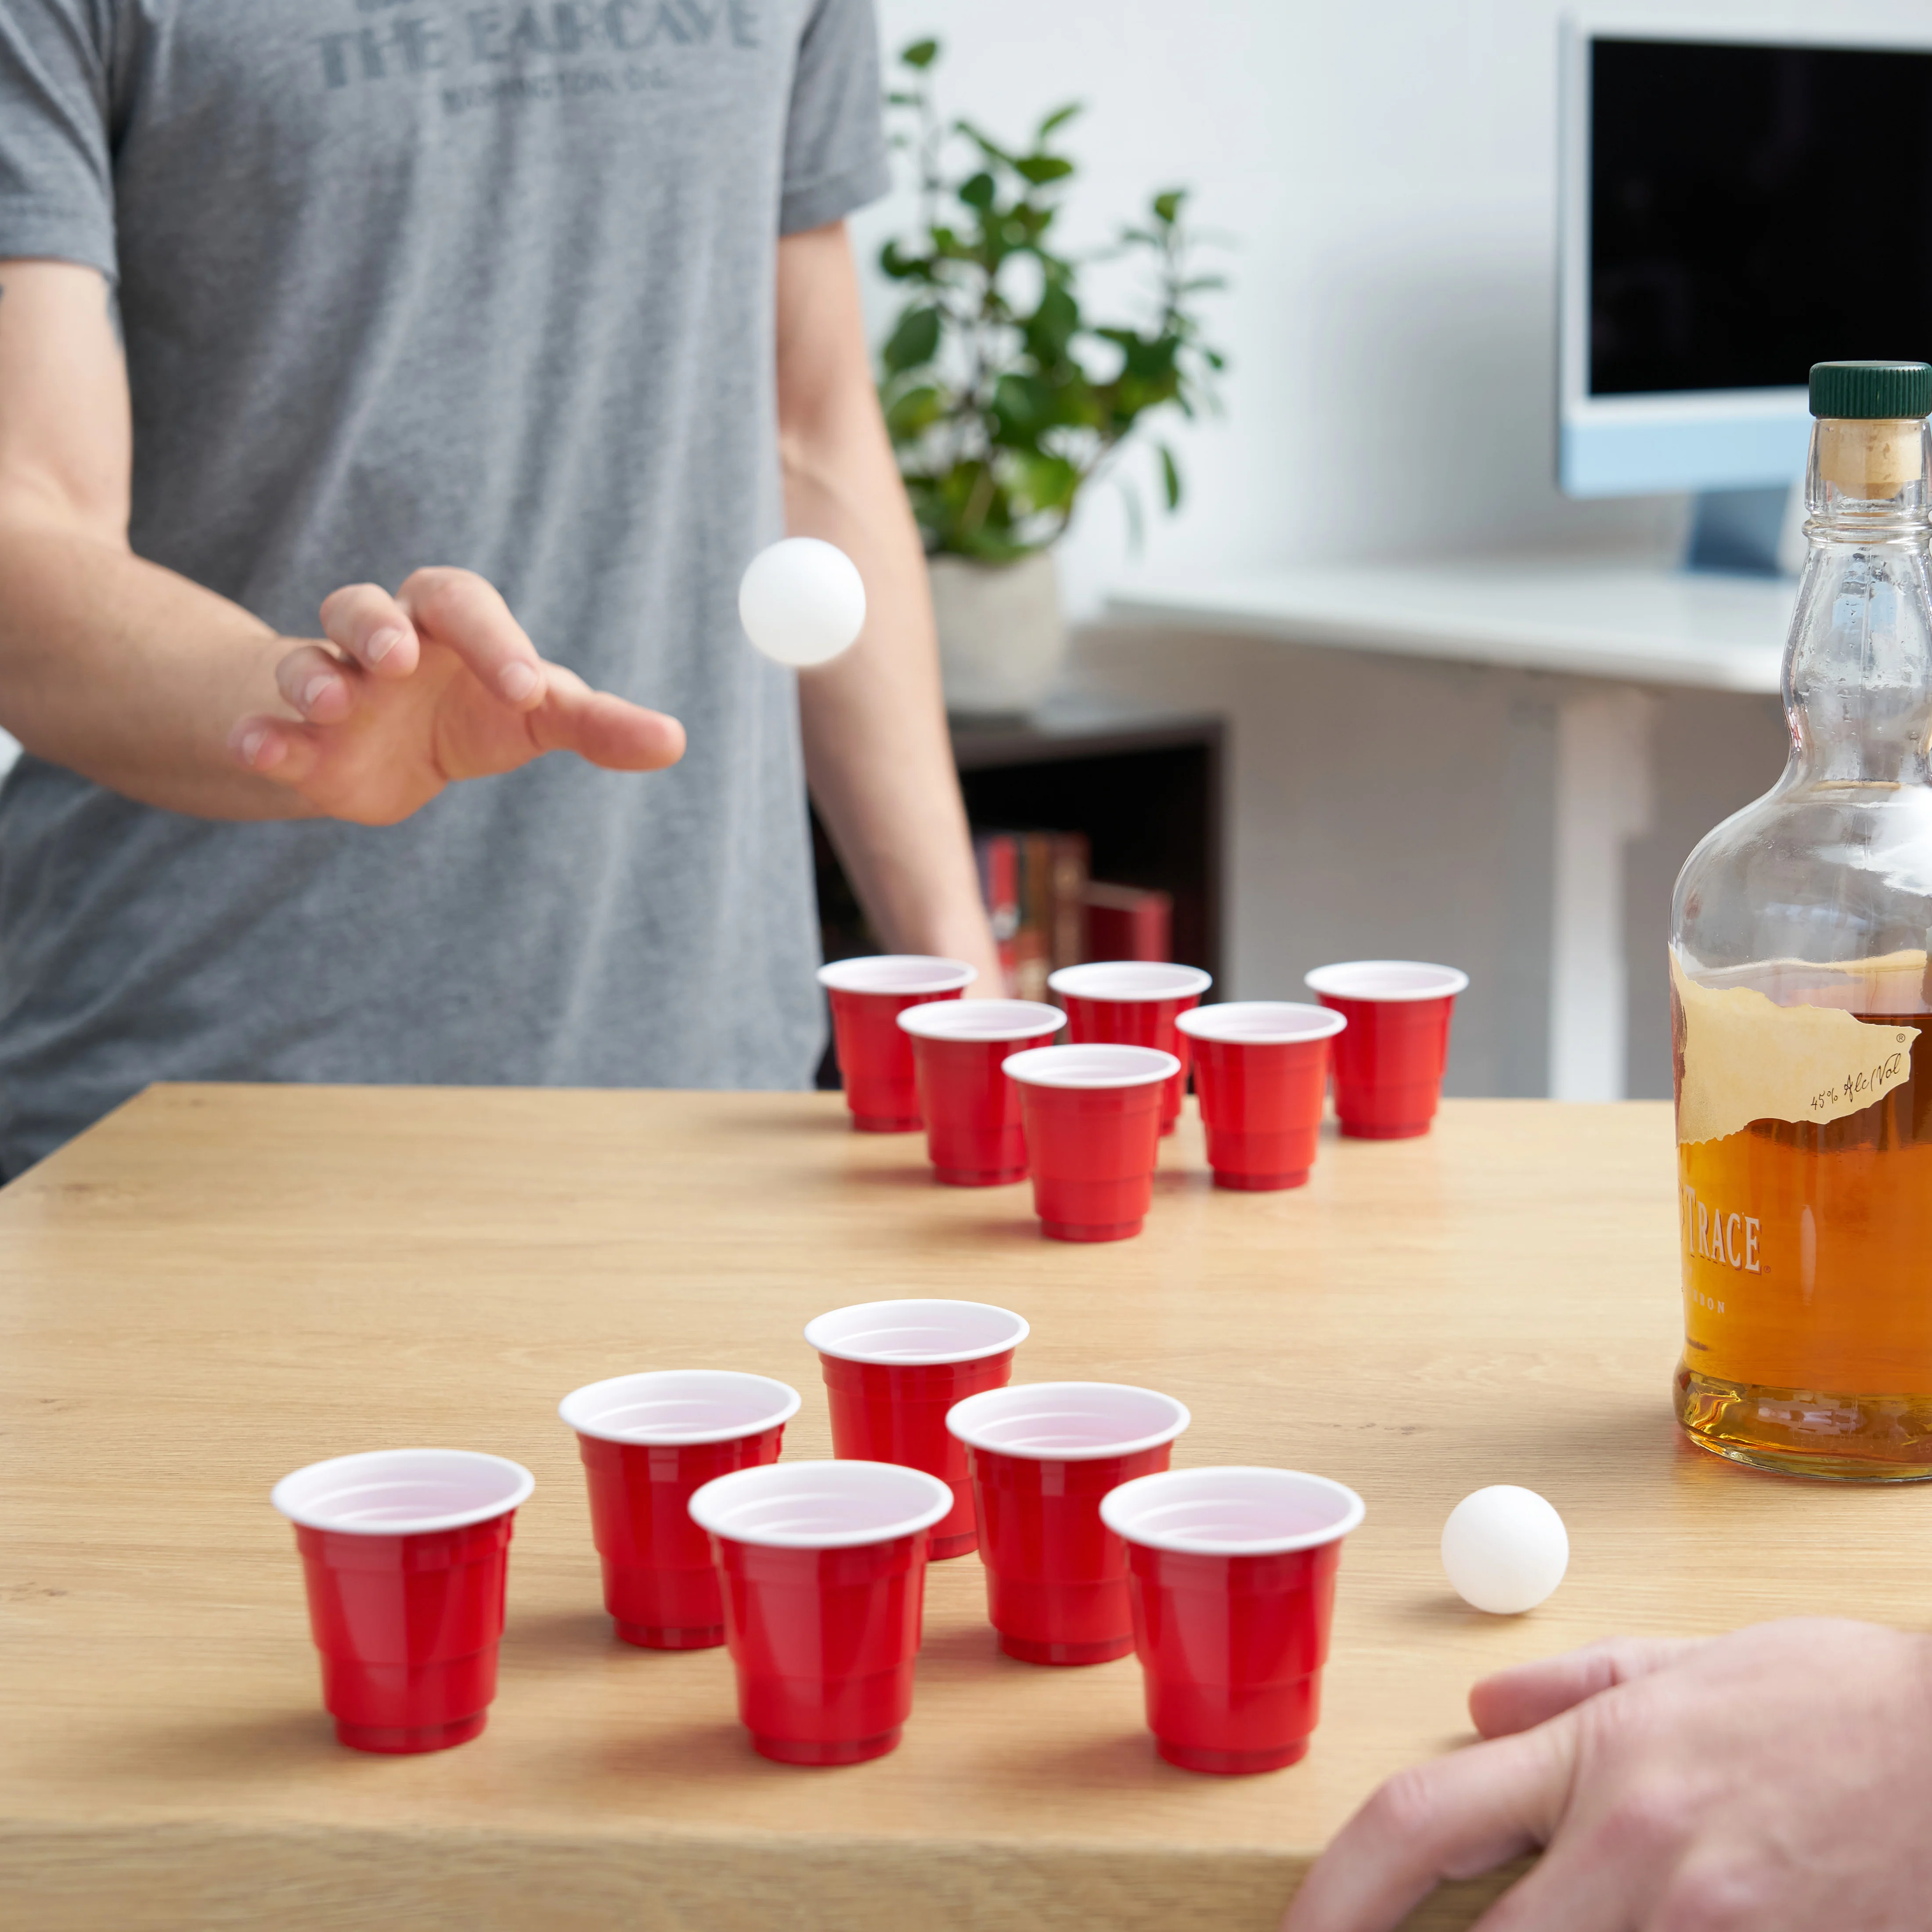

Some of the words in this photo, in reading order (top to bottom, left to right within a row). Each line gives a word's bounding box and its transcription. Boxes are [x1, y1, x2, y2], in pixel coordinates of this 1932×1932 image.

[310, 16, 444, 88] THE
[1810, 1087, 1838, 1110] 45%
[1844, 1053, 1901, 1102] Alc/Vol
